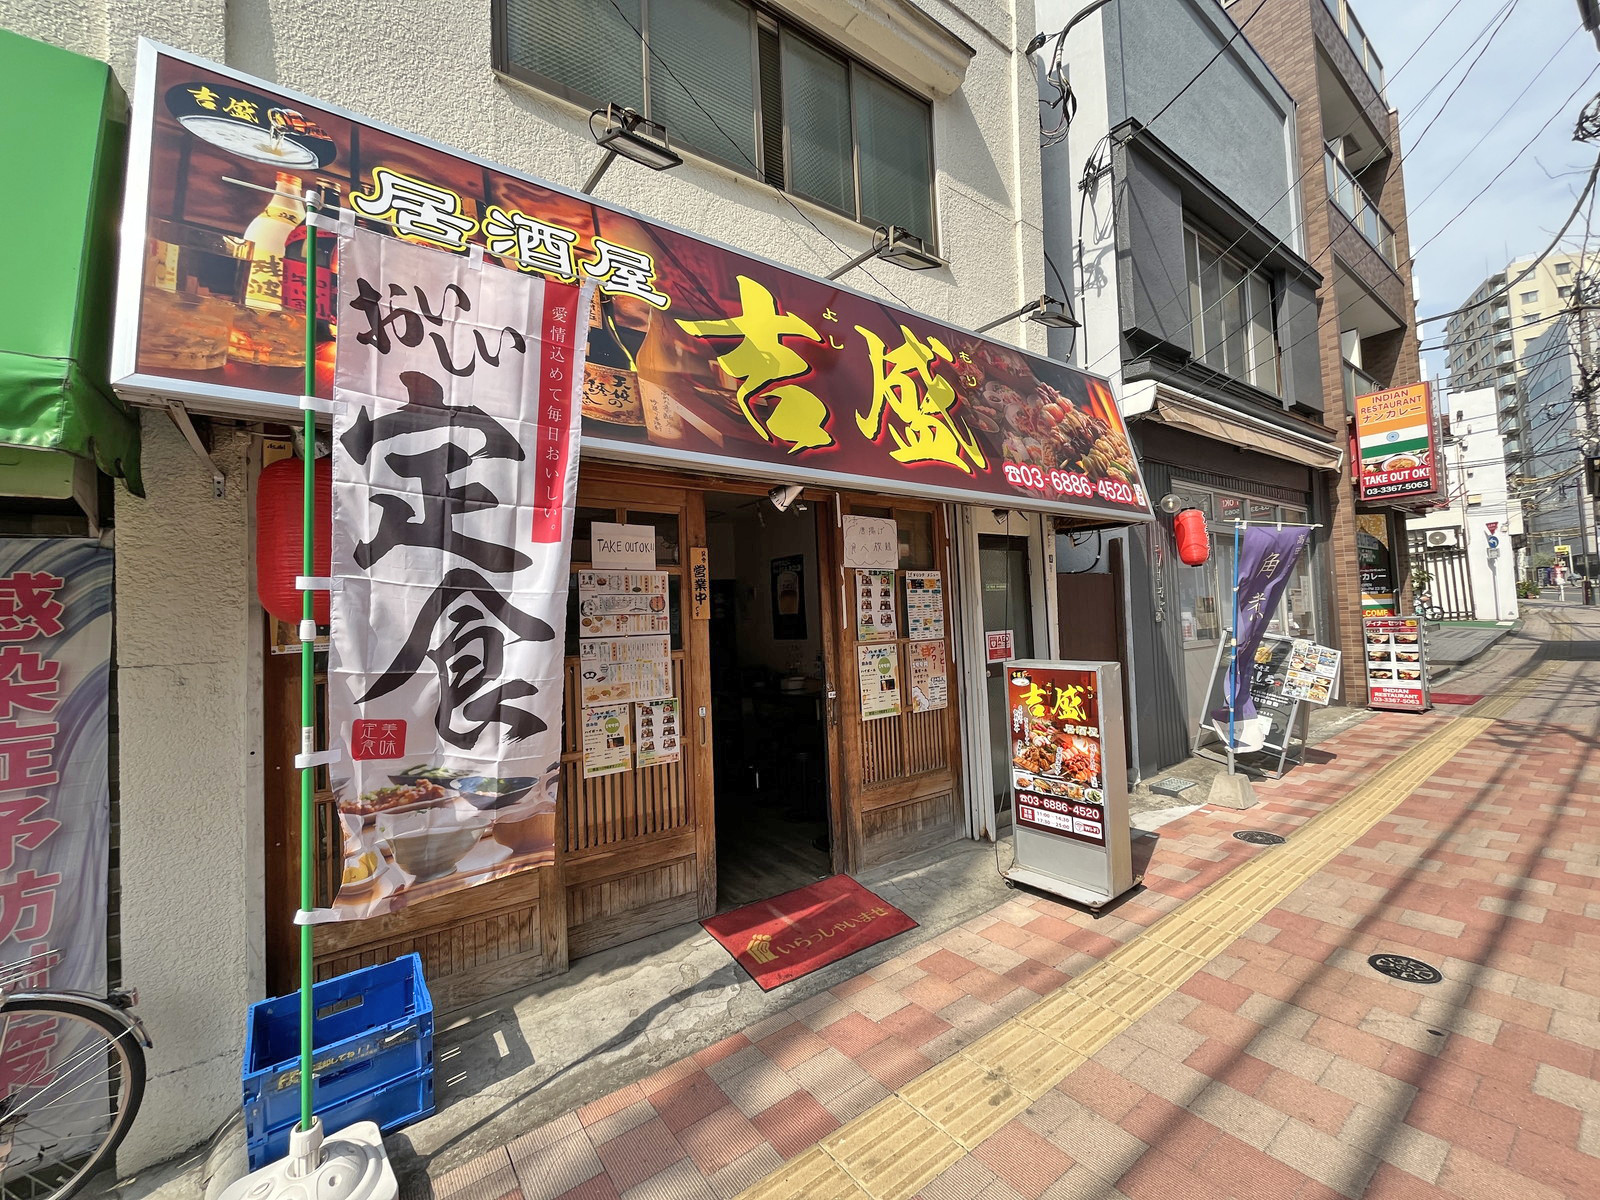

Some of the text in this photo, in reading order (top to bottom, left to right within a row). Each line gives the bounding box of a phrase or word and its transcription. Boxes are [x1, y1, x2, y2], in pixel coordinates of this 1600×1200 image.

[186, 86, 260, 125] 吉盛
[351, 168, 670, 309] 居酒屋
[349, 277, 527, 377] おいしい
[822, 307, 845, 350] よし
[674, 275, 988, 474] 吉盛
[958, 351, 978, 387] もり
[1360, 395, 1422, 415] RESTAURANT
[1372, 389, 1409, 404] INDIAN
[544, 306, 568, 531] 愛情込めて毎日おいしい。
[1362, 406, 1422, 424] ナンカレー
[1020, 465, 1133, 502] 03-6886-4520
[1364, 467, 1431, 486] TAKE OUT OK!
[1366, 480, 1429, 495] 03-3367-5063
[339, 371, 556, 751] 定食
[597, 539, 622, 553] TAKE
[694, 564, 708, 606] 営業中
[1360, 573, 1387, 581] カレー
[1019, 682, 1087, 722] 吉盛
[360, 723, 378, 756] 定食
[380, 723, 398, 756] 美味
[1027, 795, 1100, 819] 03-6886-4520
[1084, 825, 1099, 834] Wi-Fi
[777, 907, 889, 955] いらっしゃいませ
